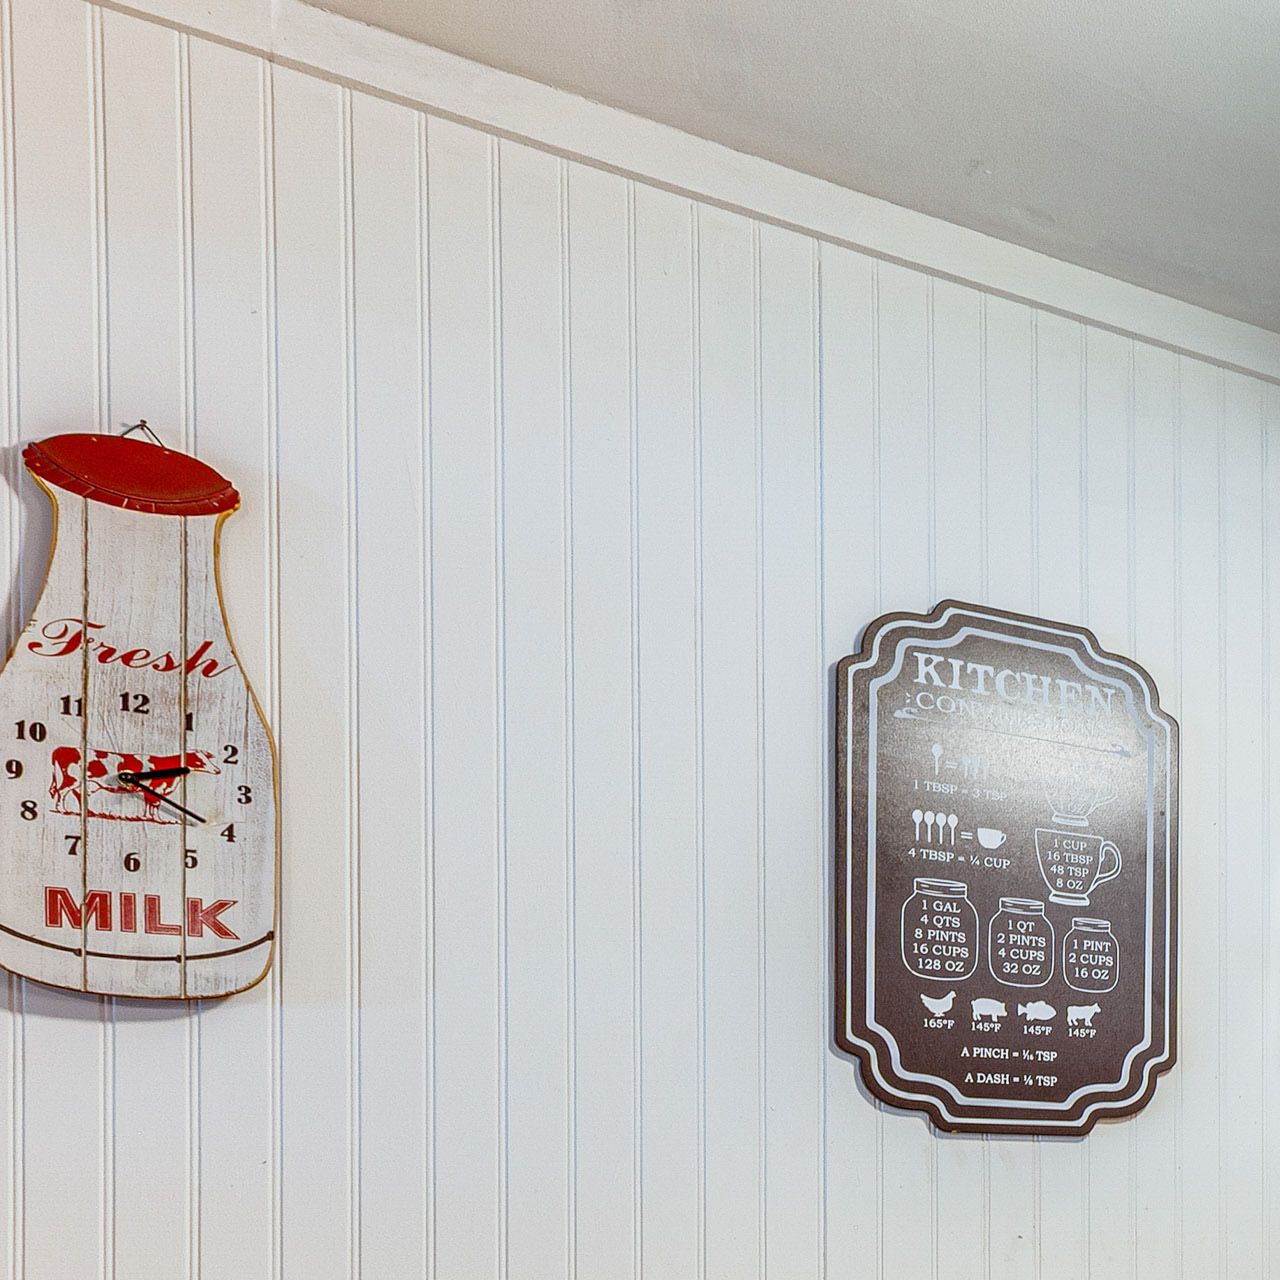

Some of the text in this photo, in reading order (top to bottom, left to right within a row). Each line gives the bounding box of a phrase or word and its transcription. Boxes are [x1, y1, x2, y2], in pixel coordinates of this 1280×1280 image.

[28, 618, 235, 678] Fresh
[913, 652, 1115, 715] KITCHEN
[60, 695, 82, 717] 11
[120, 692, 149, 714] 12
[15, 720, 46, 742] 10
[223, 745, 238, 764] 2
[6, 760, 23, 779] 9
[237, 785, 252, 804] 3
[914, 779, 919, 789] 1
[924, 781, 958, 794] TBSP
[983, 790, 1008, 801] TSP
[20, 800, 38, 820] 8
[221, 823, 236, 842] 4
[65, 835, 81, 855] 7
[1053, 839, 1087, 851] 1 CUP
[124, 853, 141, 872] 6
[184, 850, 198, 869] 5
[908, 848, 916, 858] 4
[920, 849, 954, 863] TBSP
[984, 858, 1010, 869] CUP
[1047, 852, 1093, 865] 16 TBSP
[1050, 865, 1089, 878] 48 TSP
[1056, 879, 1083, 891] 8 OZ
[45, 886, 240, 940] MILK
[922, 900, 961, 914] 1 GAL
[920, 914, 961, 928] 4 QTS
[1007, 920, 1035, 932] 1 QT
[915, 928, 966, 943] 8 PINTS
[997, 933, 1046, 948] 2 PINTS
[913, 943, 969, 958] 16 CUPS
[1073, 939, 1111, 952] 1 PINT
[998, 948, 1045, 961] 4 CUPS
[1069, 953, 1114, 967] 2 CUPS
[917, 958, 965, 973] 128 OZ
[1003, 963, 1041, 976] 32 OZ
[1074, 967, 1110, 980] 16 OZ
[961, 1047, 970, 1058] A
[972, 1048, 1009, 1060] PINCH
[1036, 1050, 1058, 1062] TSP
[965, 1073, 973, 1083] A
[977, 1073, 1009, 1085] DASH
[1036, 1075, 1058, 1087] TSP
